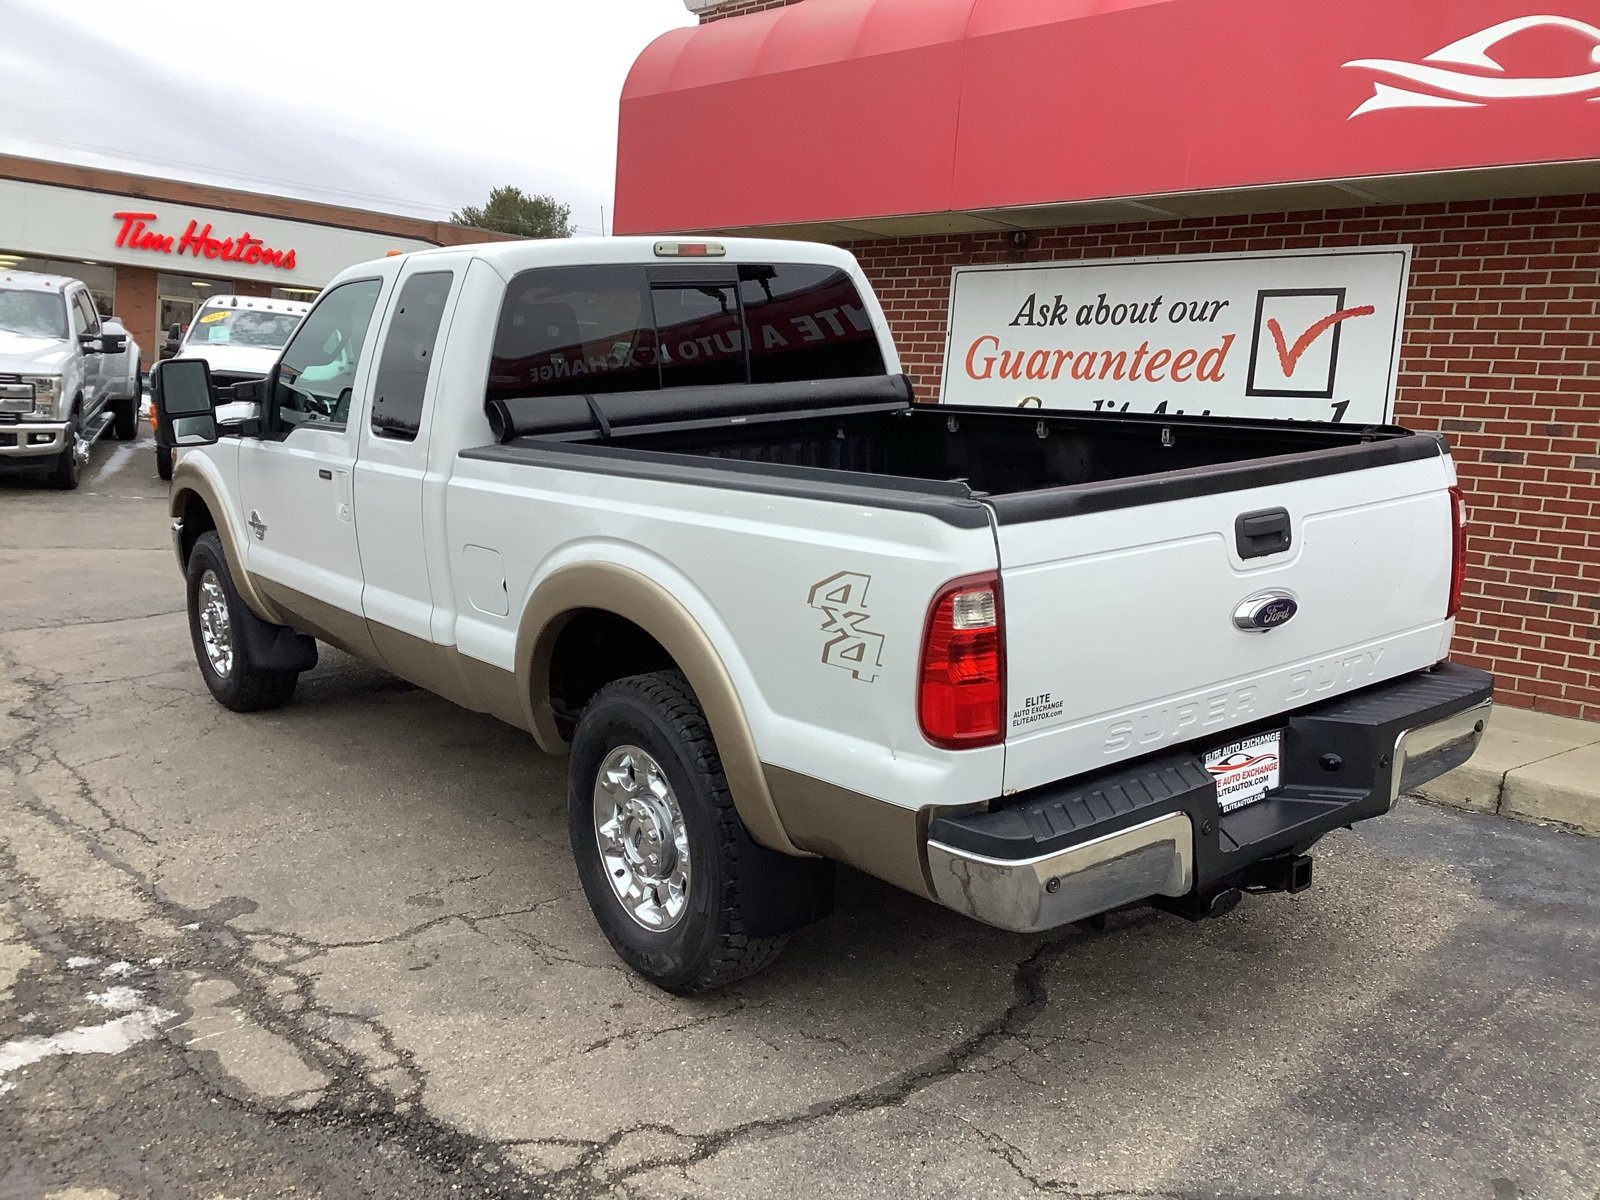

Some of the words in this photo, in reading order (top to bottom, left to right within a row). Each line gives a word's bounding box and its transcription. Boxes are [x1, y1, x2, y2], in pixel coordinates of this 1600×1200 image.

[113, 212, 174, 253] Tim
[177, 219, 296, 270] Hortons
[1009, 292, 1069, 327] Ask
[1075, 290, 1164, 326] about
[1168, 297, 1230, 323] our
[965, 333, 1236, 383] Guaranteed
[1263, 604, 1290, 623] Ford
[1012, 709, 1030, 719] AUTO
[1031, 700, 1064, 714] EXCHANGE
[1025, 693, 1051, 708] ELITE
[1103, 684, 1258, 754] SUPER
[1285, 647, 1385, 701] DUTY
[1012, 710, 1063, 727] ELITEAUTOX.com
[1205, 748, 1222, 761] ELITE
[1222, 742, 1240, 756] AUTO
[1241, 731, 1281, 750] EXCHANGE
[1217, 775, 1269, 797] LITEAUTOX.COM
[1222, 773, 1240, 786] AUTO
[1242, 761, 1278, 780] EXCHANGE
